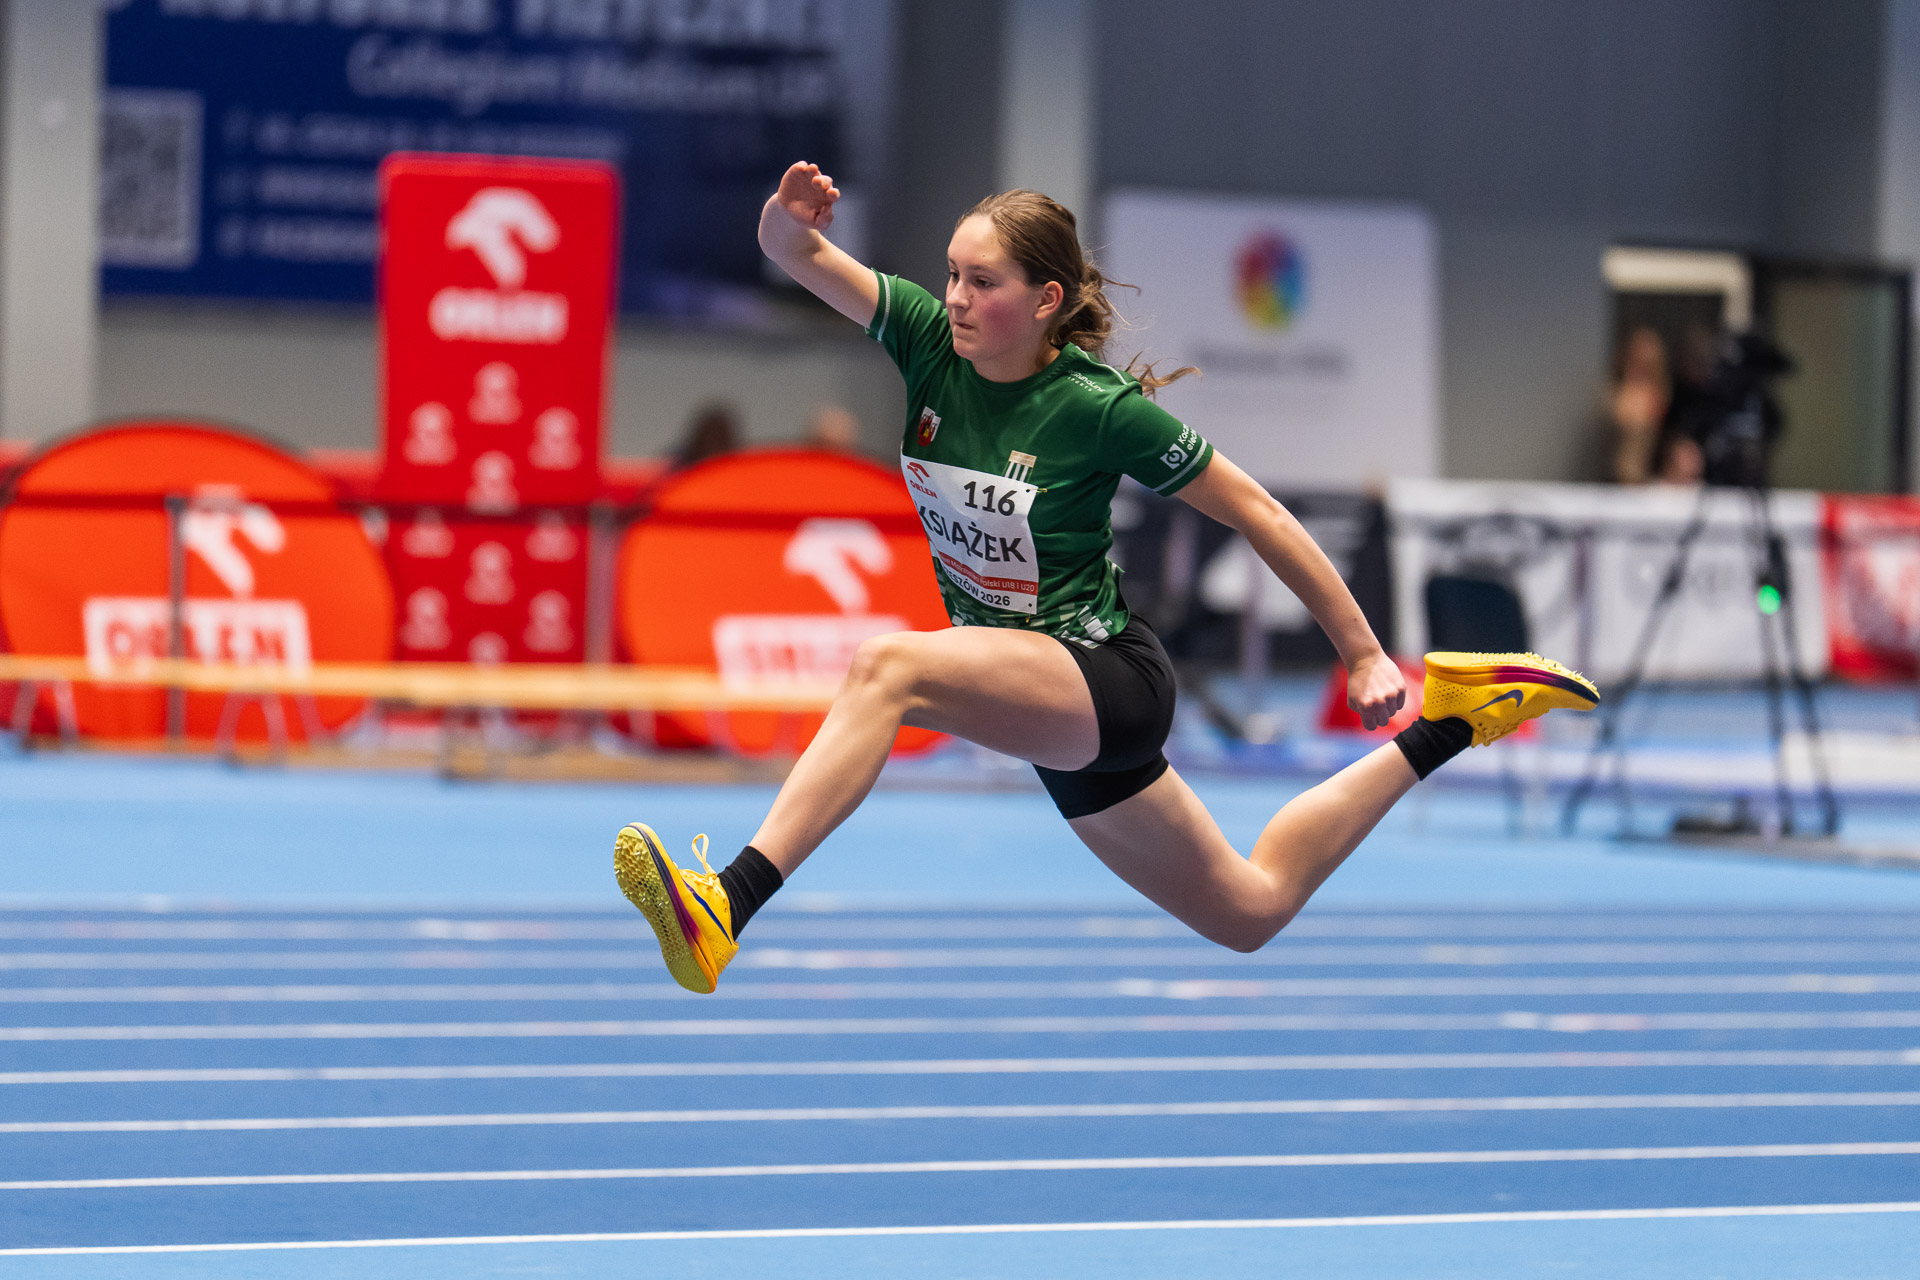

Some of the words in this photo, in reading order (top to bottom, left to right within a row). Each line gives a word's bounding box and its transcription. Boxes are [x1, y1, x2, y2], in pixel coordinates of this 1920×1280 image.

[910, 480, 938, 499] ORLEN
[963, 480, 1018, 517] 116
[1001, 581, 1015, 589] U18
[1020, 583, 1035, 592] U20
[980, 591, 1011, 606] 2026
